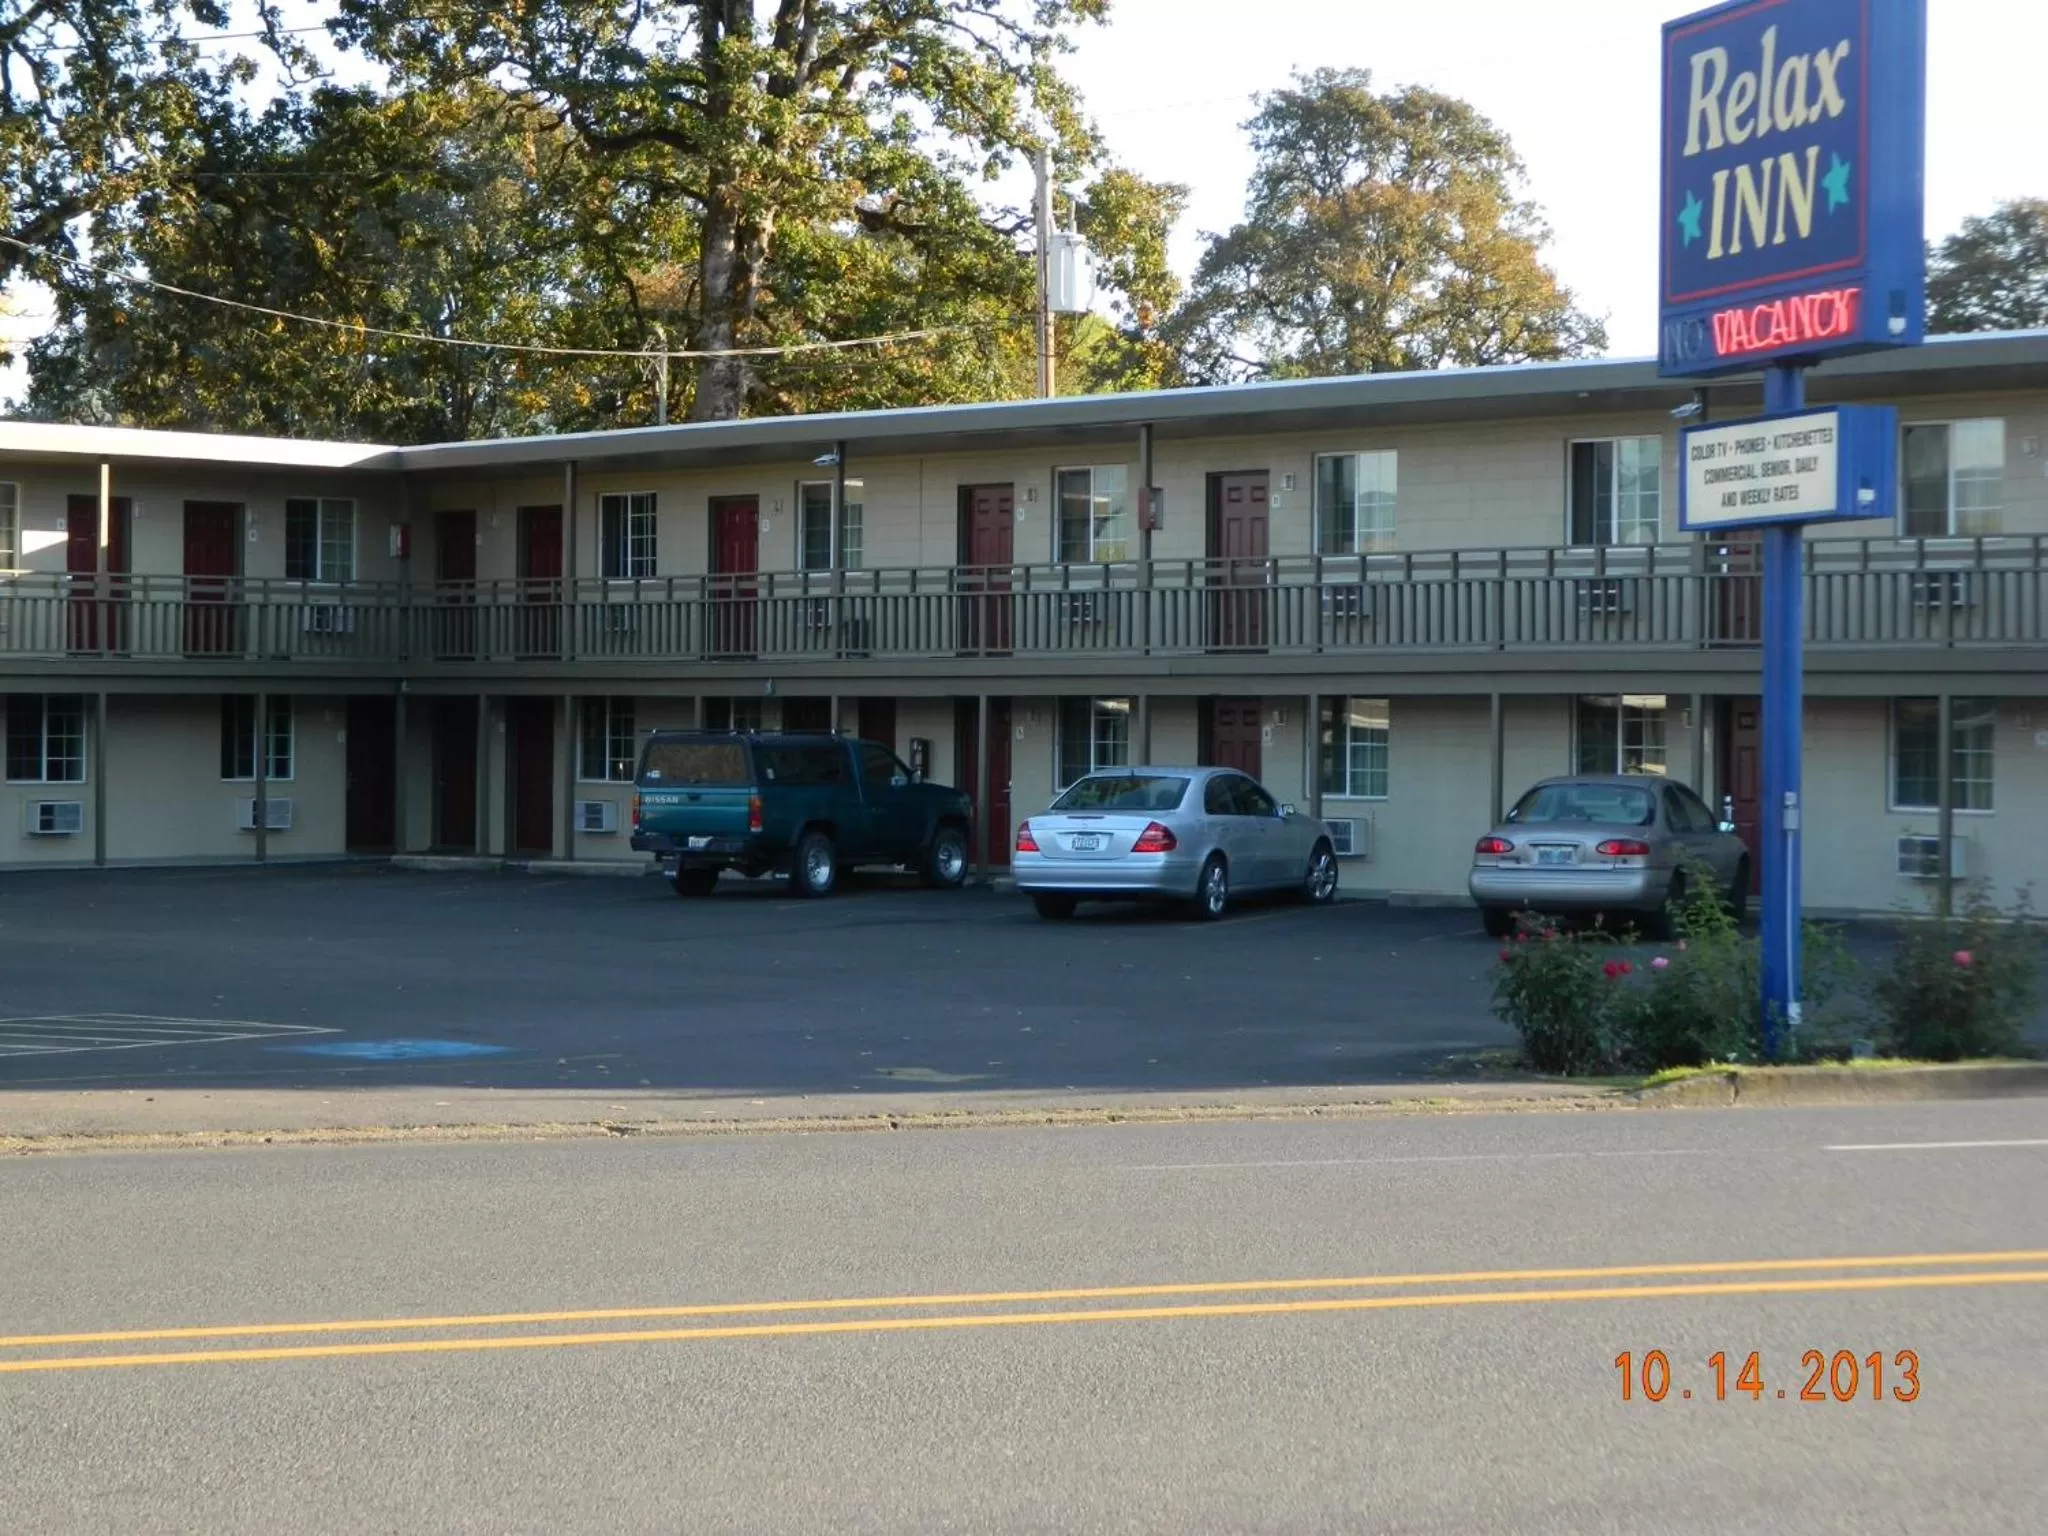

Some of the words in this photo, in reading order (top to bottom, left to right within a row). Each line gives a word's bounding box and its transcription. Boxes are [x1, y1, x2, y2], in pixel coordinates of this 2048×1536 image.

[1683, 24, 1850, 156] Relax
[1706, 145, 1821, 260] INN
[1662, 318, 1706, 368] NO
[1712, 288, 1861, 356] VACANCY
[1691, 444, 1715, 461] COLOR
[1718, 442, 1728, 457] TV
[1734, 437, 1766, 455] PHONES
[1795, 456, 1819, 474] DAILY
[1721, 491, 1737, 507] AND
[1740, 487, 1771, 506] WEEKLY
[1773, 484, 1799, 502] RATES
[645, 796, 678, 804] NISSAN
